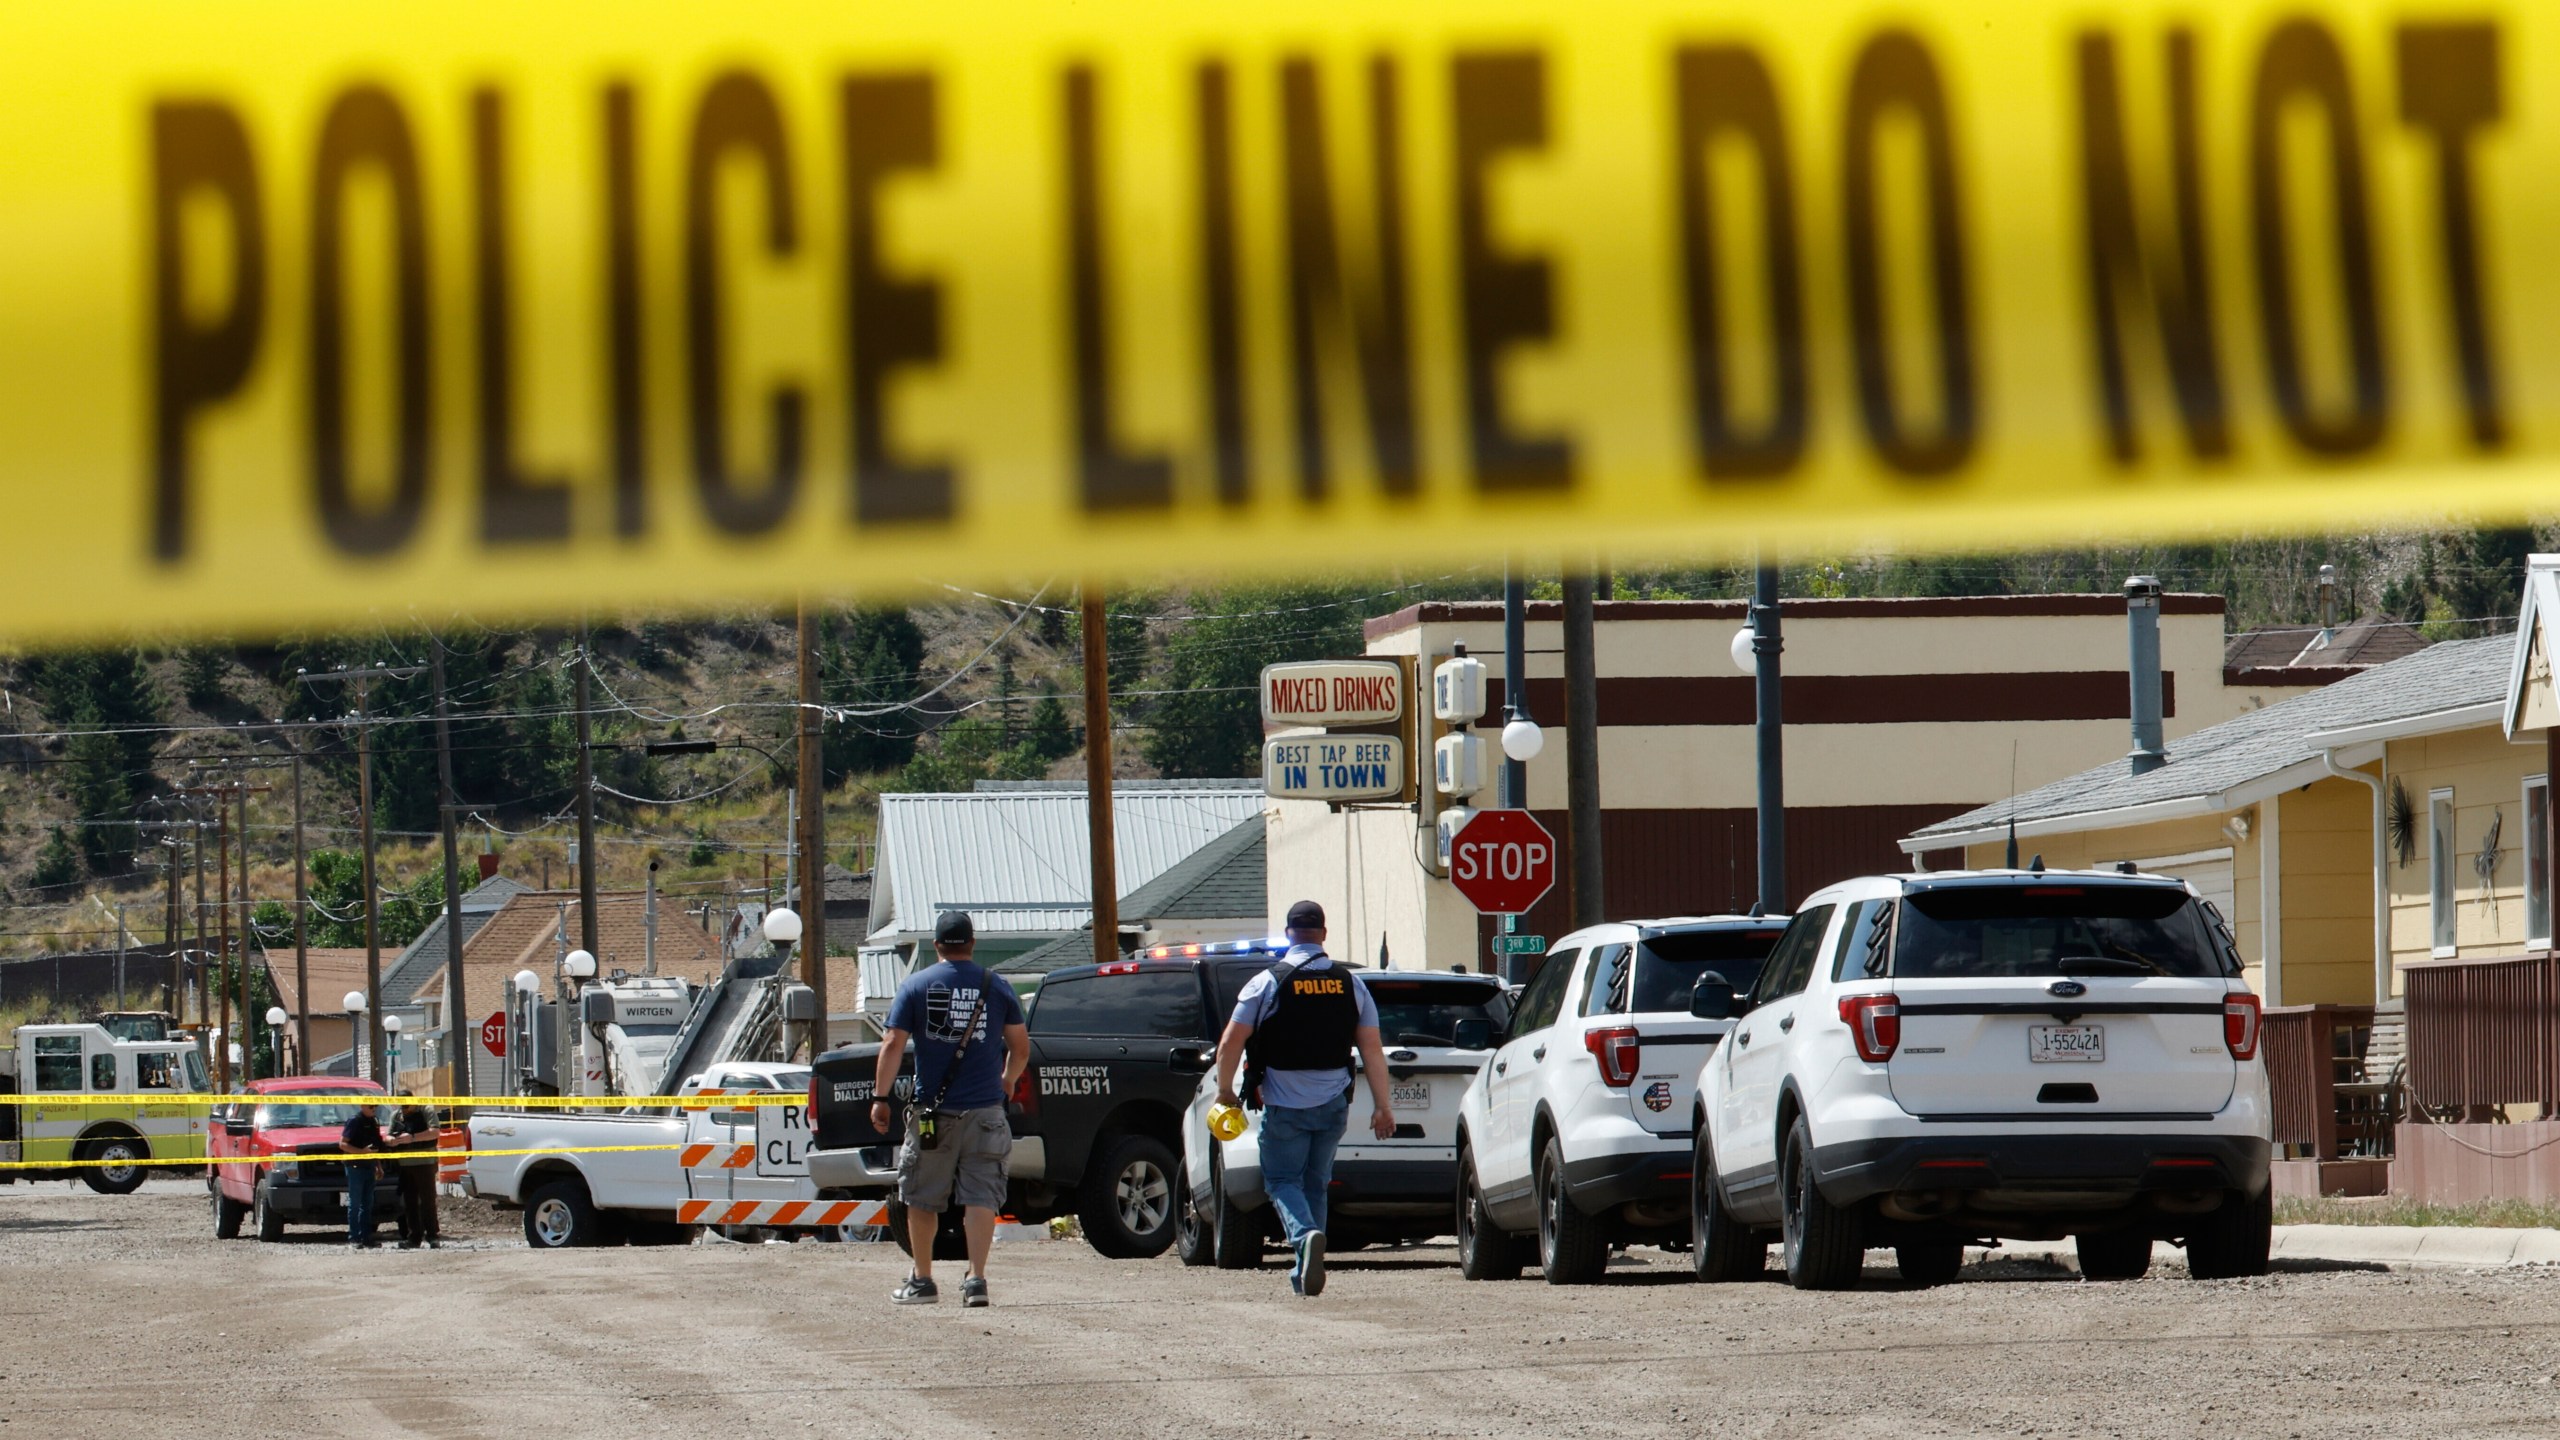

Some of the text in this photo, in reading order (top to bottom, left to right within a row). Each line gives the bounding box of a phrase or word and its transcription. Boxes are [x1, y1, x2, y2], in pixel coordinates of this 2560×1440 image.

[145, 15, 2512, 568] POLICE LINE DO NOT
[1272, 676, 1396, 713] MIXED DRINKS
[1276, 744, 1391, 764] BEST TAP BEER
[1284, 764, 1386, 789] IN TOWN
[1457, 842, 1547, 881] STOP
[1507, 938, 1541, 952] 3RD ST
[952, 988, 981, 1000] A FIR
[1293, 979, 1345, 995] POLICE
[626, 1007, 673, 1017] WIRTGEN
[951, 1000, 987, 1012] FIGHT
[484, 1024, 505, 1043] ST
[2044, 1034, 2100, 1051] 1-55242A
[1039, 1066, 1108, 1078] EMERGENCY
[834, 1080, 876, 1091] EMERGENCY
[1391, 1087, 1428, 1101] -50636A
